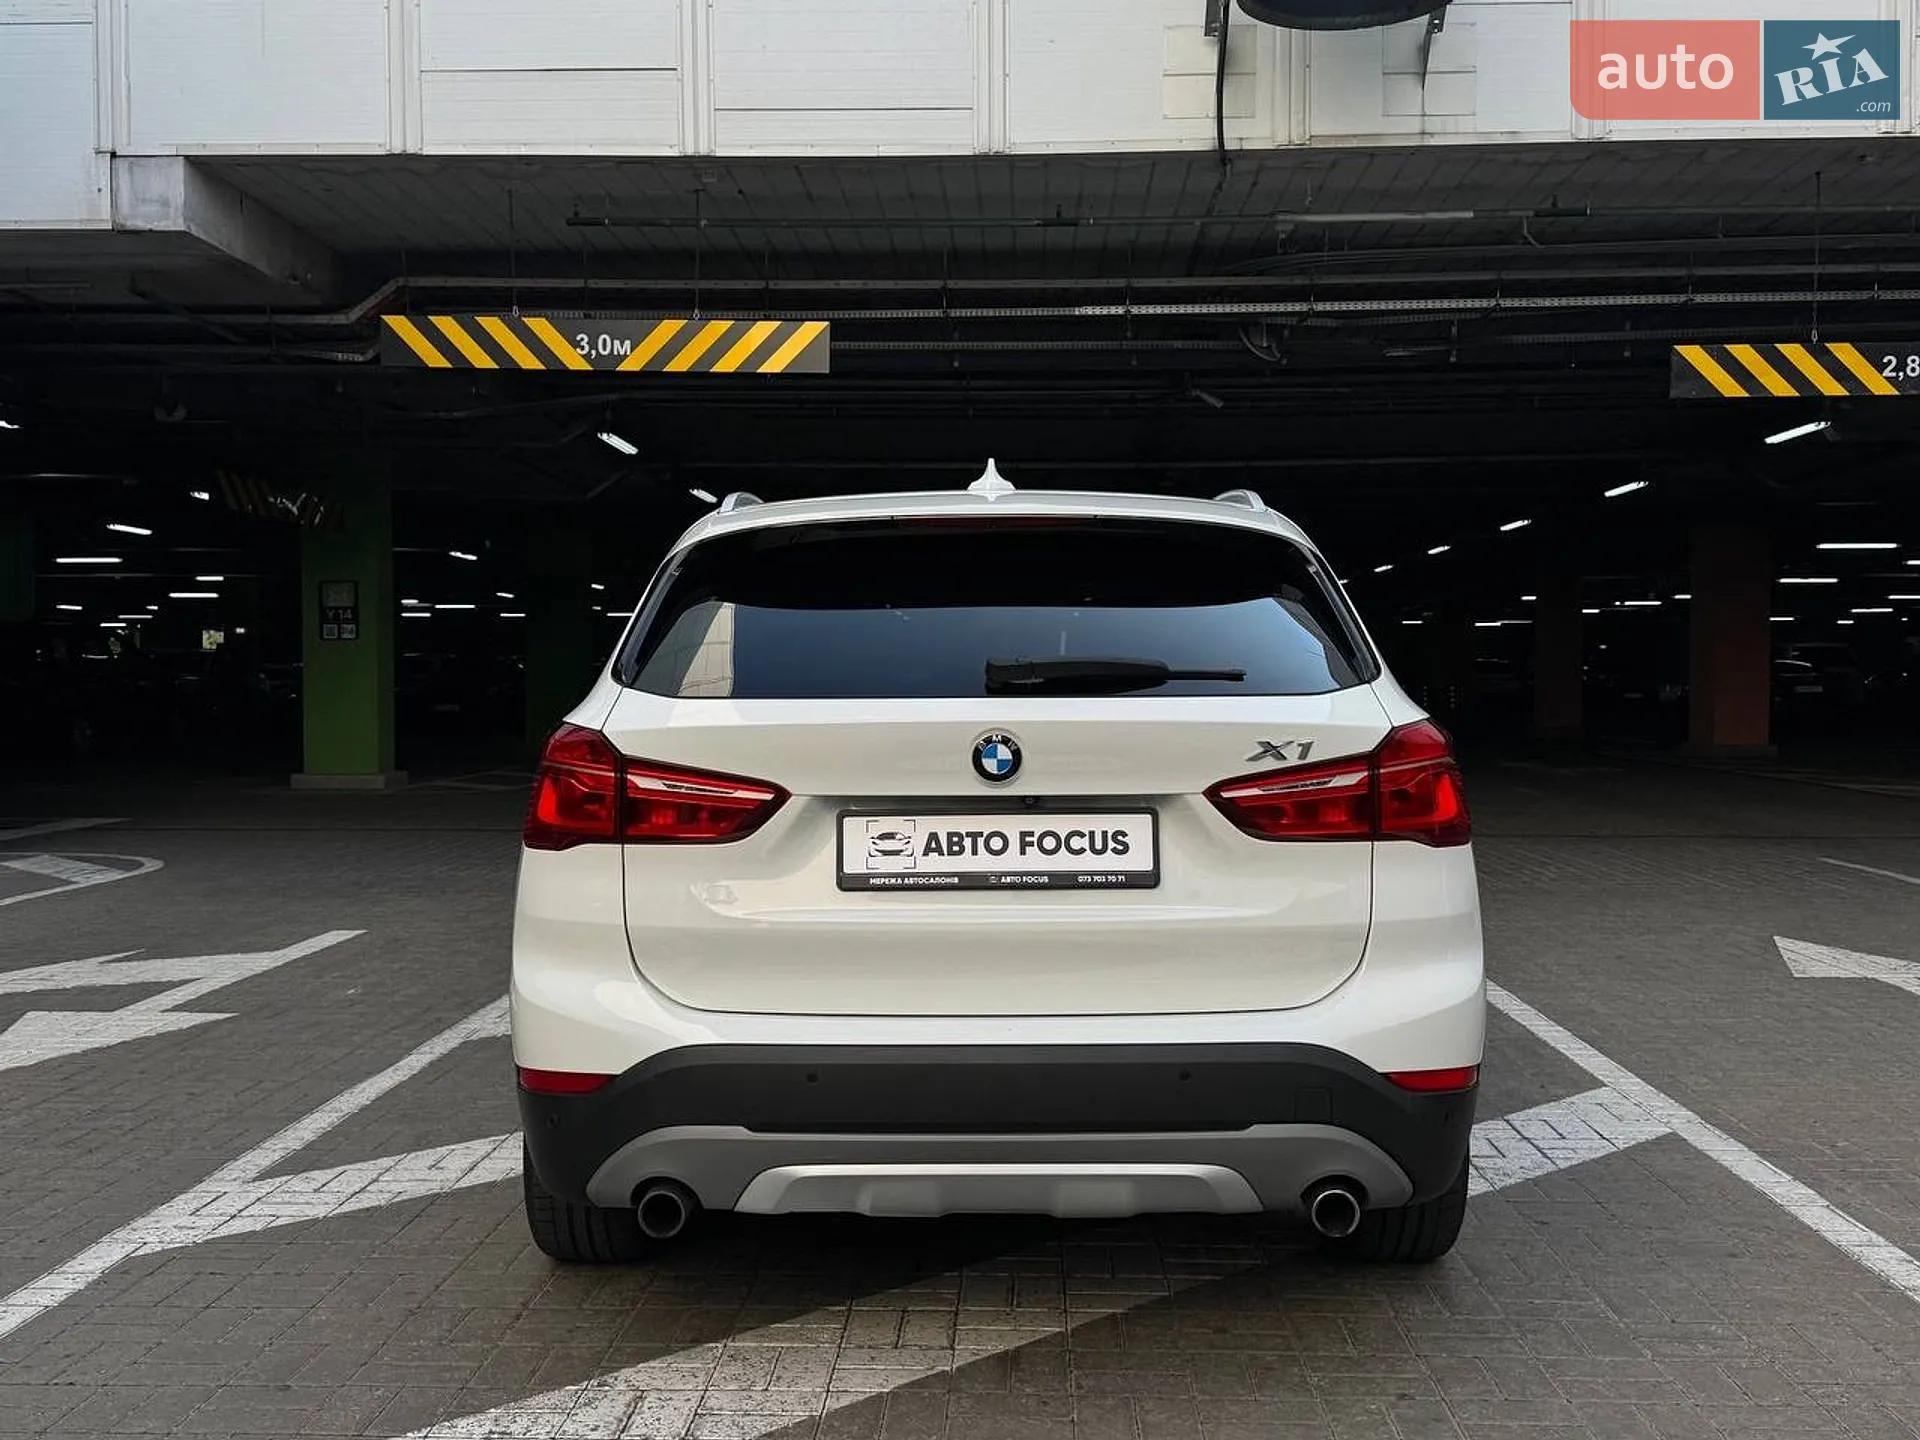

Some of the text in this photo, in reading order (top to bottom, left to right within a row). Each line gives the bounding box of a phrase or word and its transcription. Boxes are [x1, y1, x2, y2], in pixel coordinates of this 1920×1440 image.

[575, 333, 632, 359] 3,0м
[1244, 740, 1315, 762] X1
[922, 829, 1131, 857] АВТО FOCUS
[1022, 875, 1049, 883] FOCUS
